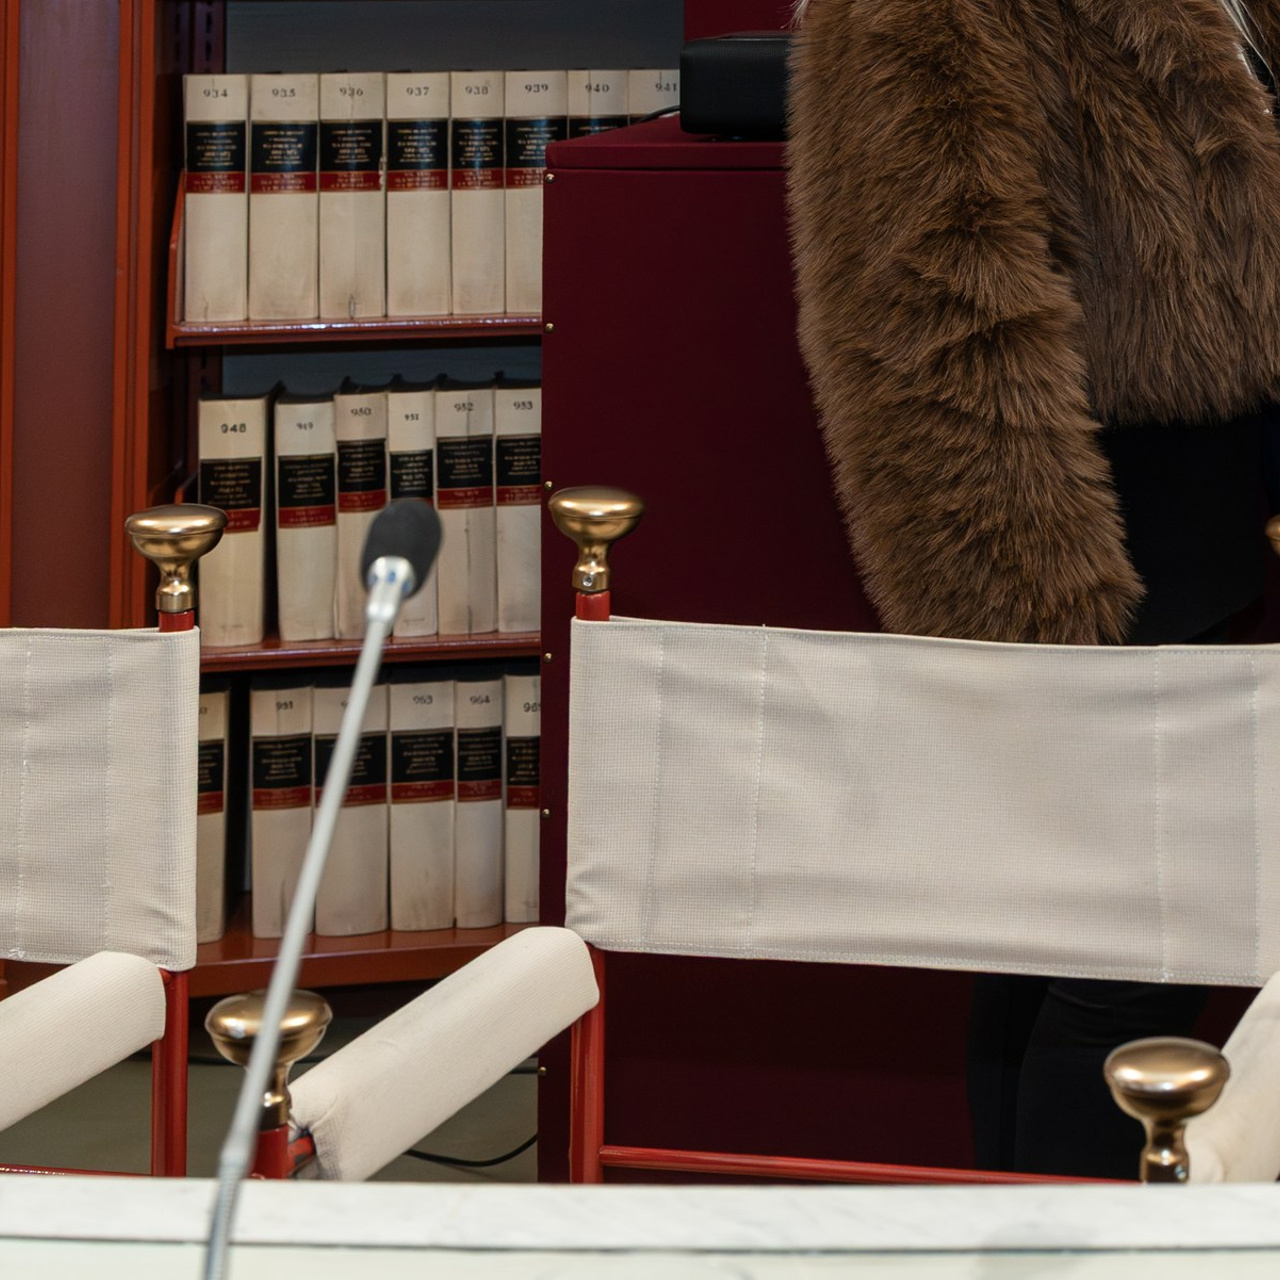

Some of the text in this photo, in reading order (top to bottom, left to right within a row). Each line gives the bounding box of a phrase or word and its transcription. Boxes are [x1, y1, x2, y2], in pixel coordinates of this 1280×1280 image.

[340, 87, 363, 97] 936
[406, 86, 430, 96] 937
[465, 85, 489, 95] 938
[525, 83, 549, 93] 939
[585, 83, 610, 93] 940
[655, 82, 677, 92] 941
[203, 89, 228, 98] 934
[272, 88, 295, 98] 935
[454, 402, 474, 412] 952
[513, 401, 533, 410] 953
[350, 407, 372, 416] 950
[220, 423, 246, 434] 948
